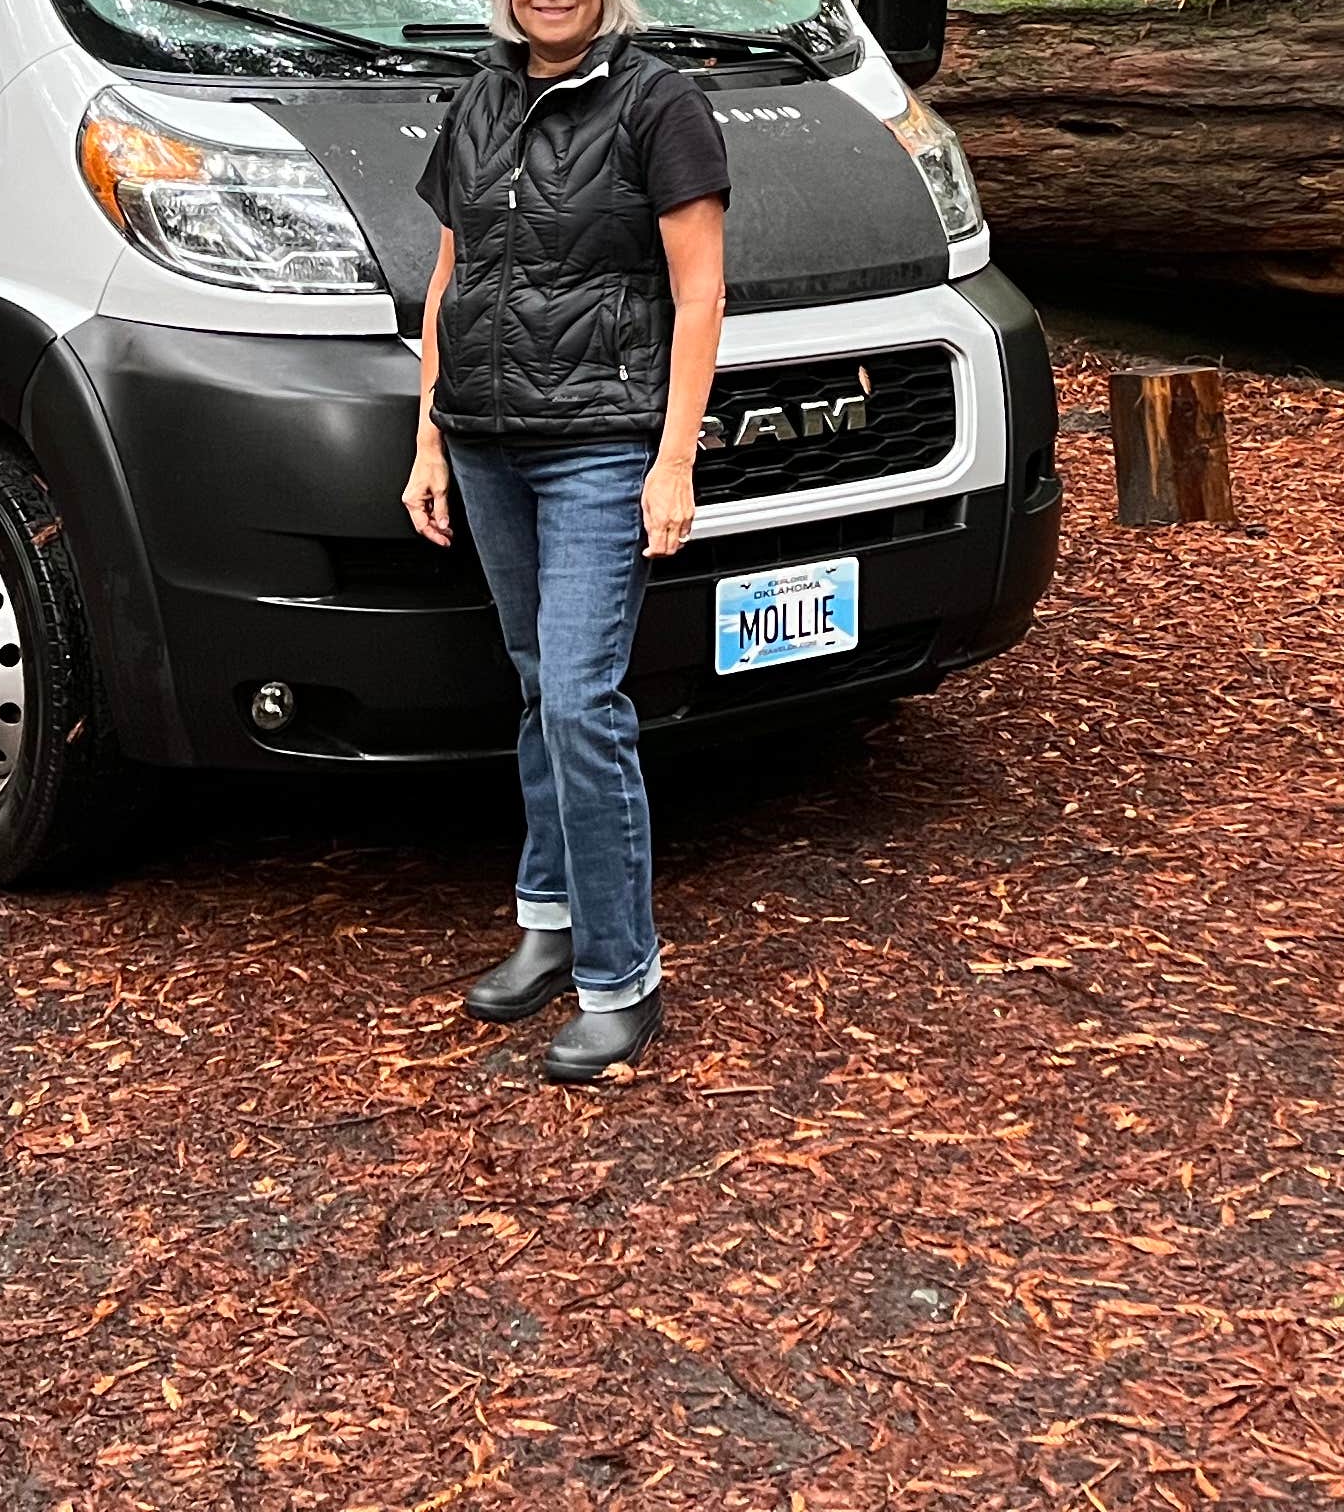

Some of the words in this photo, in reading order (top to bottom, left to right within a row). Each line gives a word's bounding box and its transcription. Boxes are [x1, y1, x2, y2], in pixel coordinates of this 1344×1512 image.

[698, 394, 867, 451] RAM
[753, 580, 822, 600] OKLAHOMA
[739, 594, 835, 649] MOLLIE
